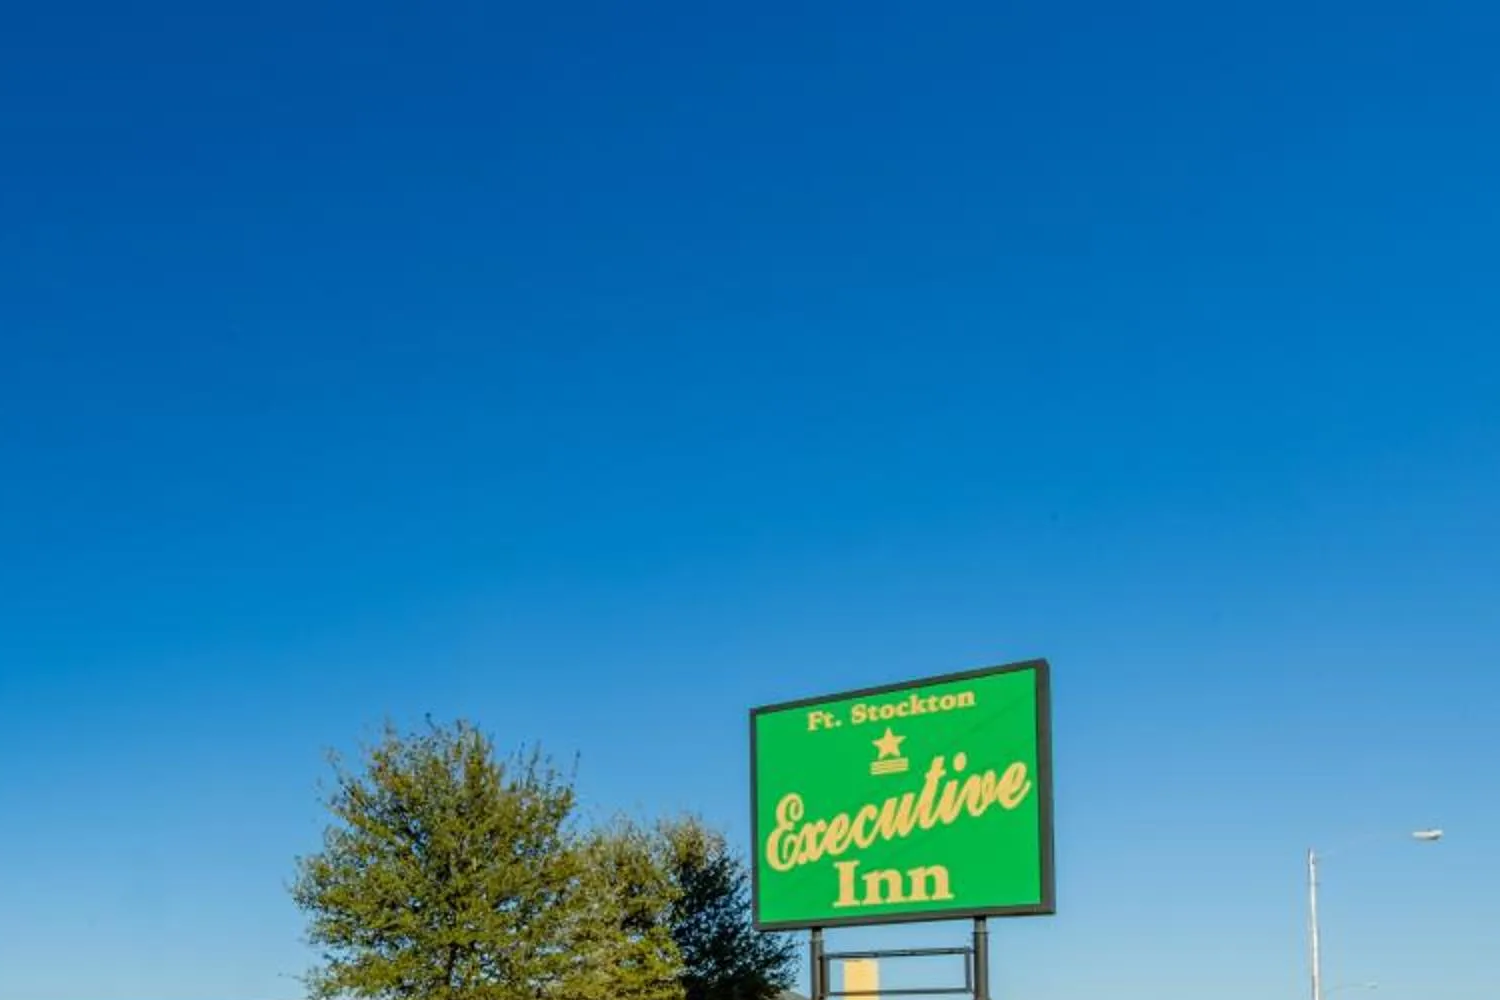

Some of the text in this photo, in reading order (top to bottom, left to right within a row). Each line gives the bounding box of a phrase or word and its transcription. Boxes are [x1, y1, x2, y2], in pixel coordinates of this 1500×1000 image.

[807, 691, 975, 731] Ft. Stockton
[766, 752, 1031, 871] Executive
[833, 860, 954, 908] Inn
